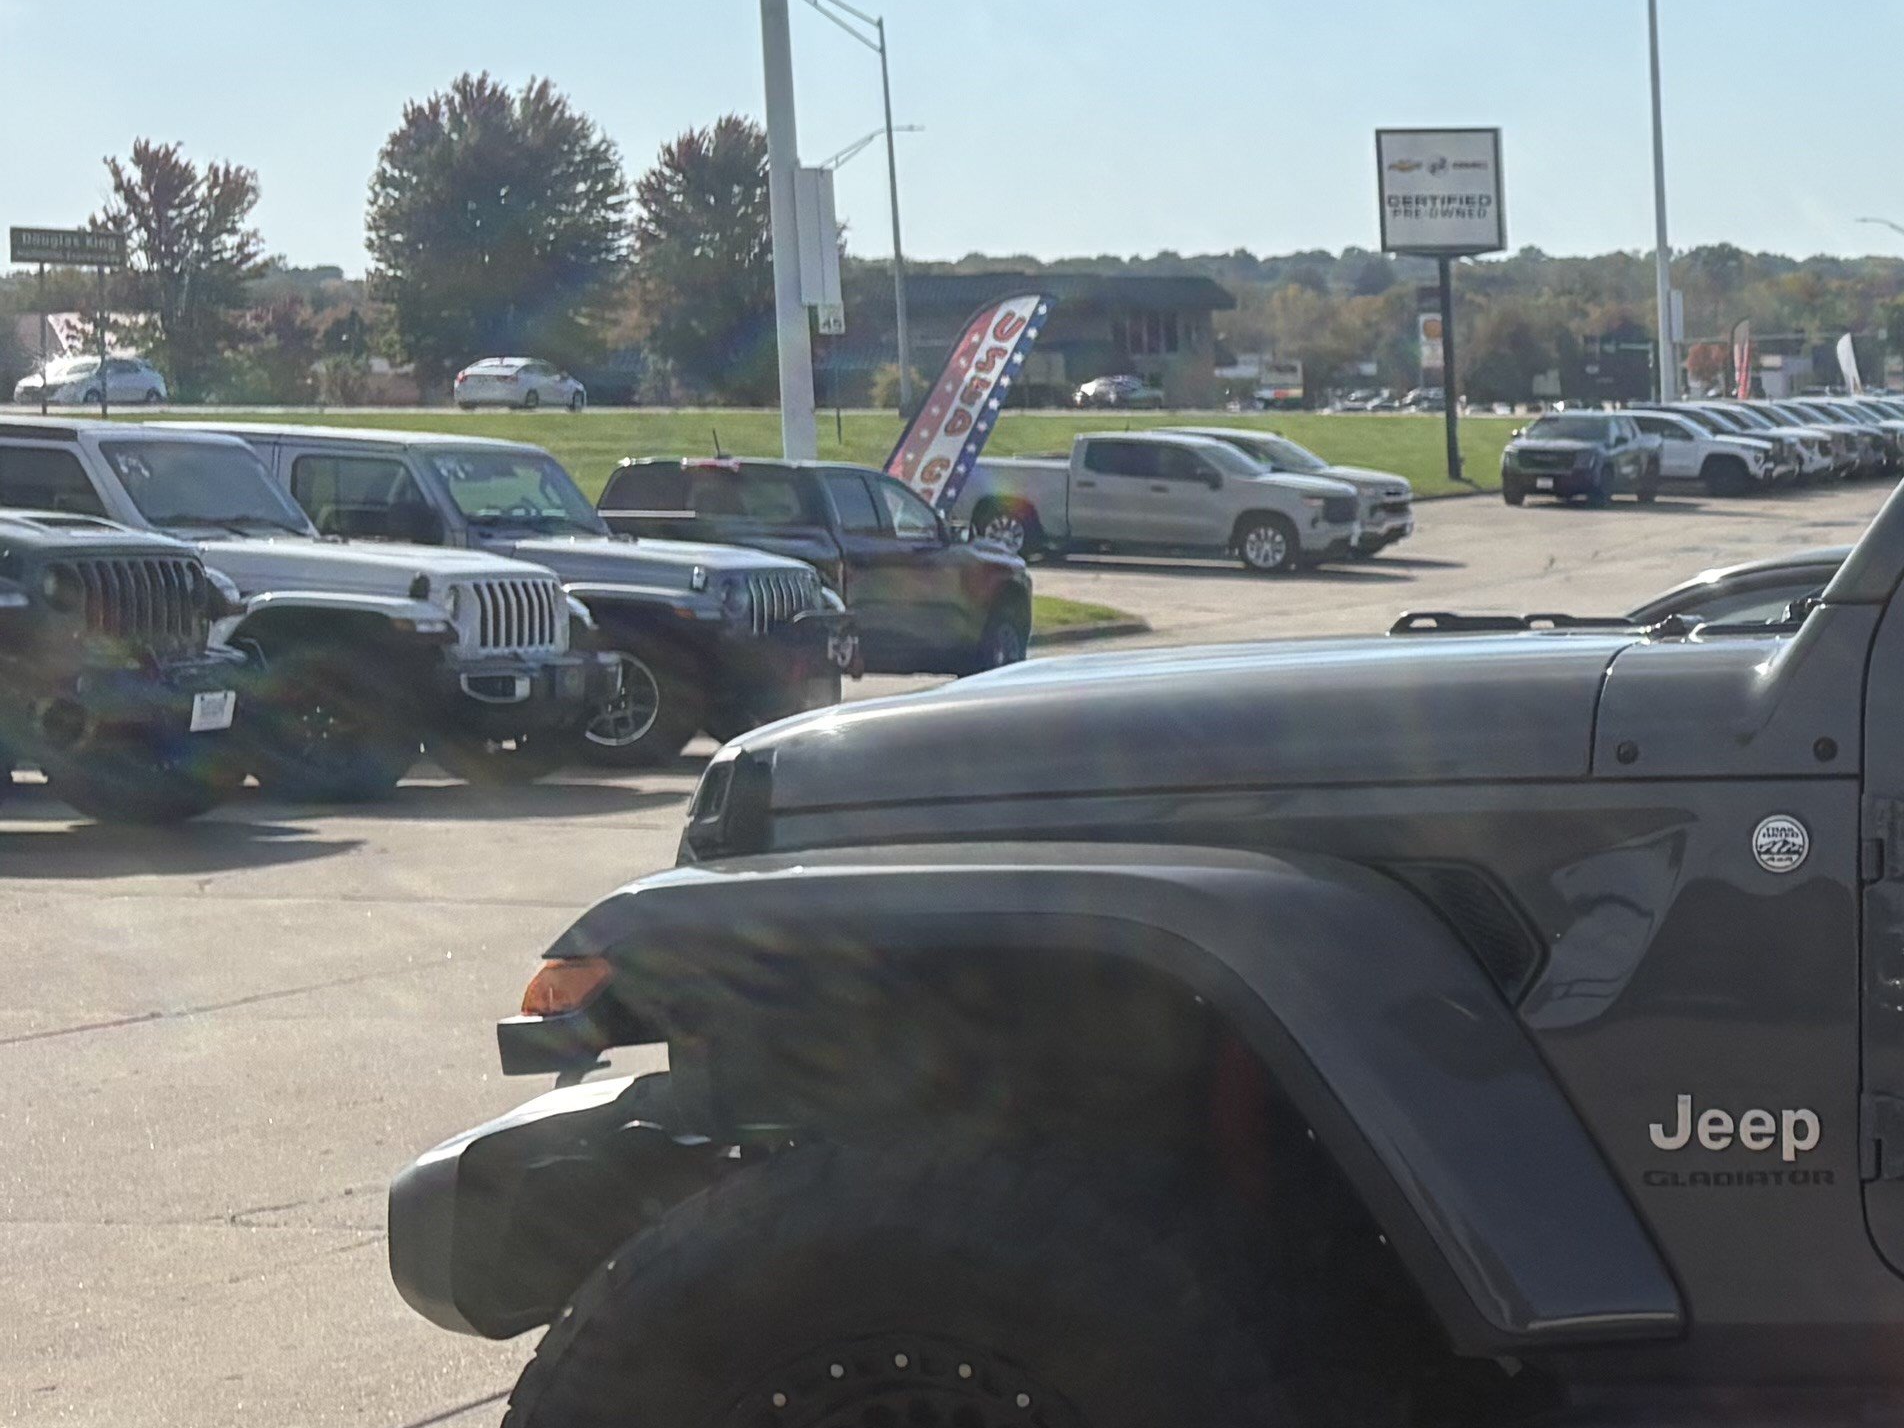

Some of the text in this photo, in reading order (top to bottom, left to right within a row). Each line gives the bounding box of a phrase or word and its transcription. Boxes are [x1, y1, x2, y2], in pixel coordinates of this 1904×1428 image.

[1388, 194, 1491, 208] CERTIFIED
[944, 310, 1027, 438] USED
[1649, 1094, 1820, 1161] Jeep
[1643, 1170, 1835, 1188] GLADIATOR
